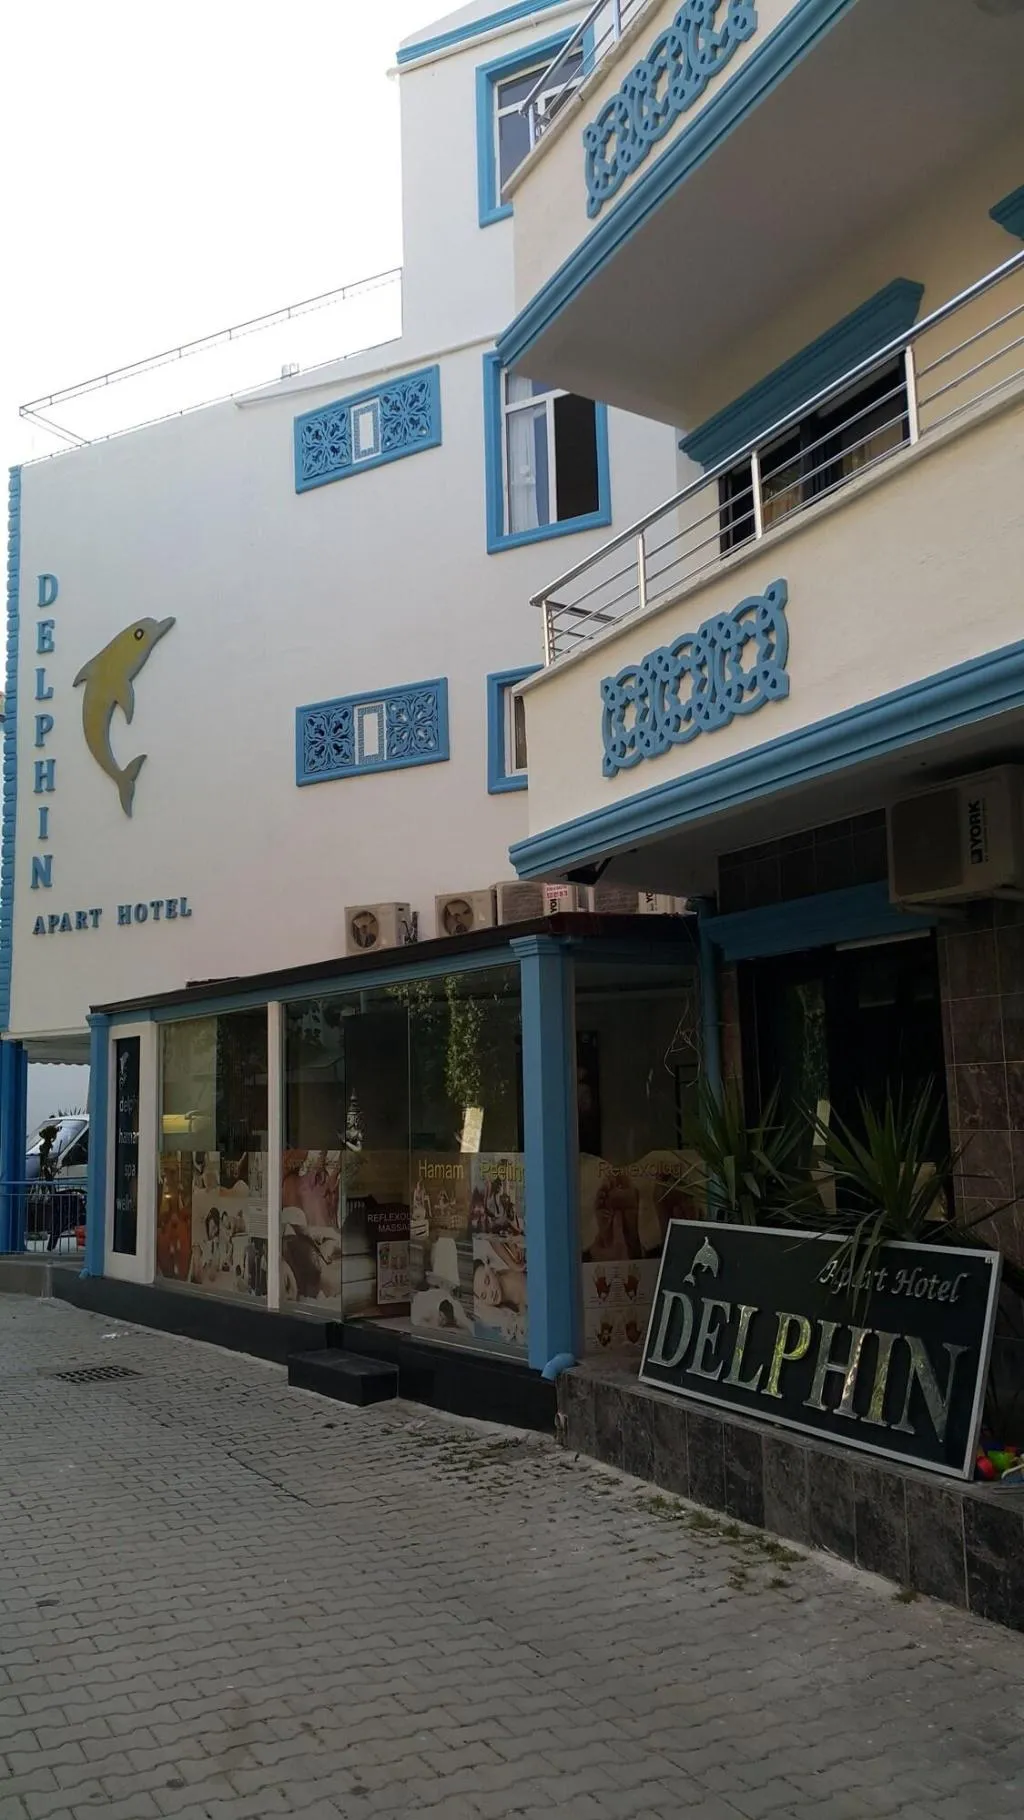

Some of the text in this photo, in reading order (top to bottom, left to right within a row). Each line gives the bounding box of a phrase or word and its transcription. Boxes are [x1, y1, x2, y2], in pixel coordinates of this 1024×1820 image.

[30, 573, 59, 889] DELPHIN
[968, 799, 981, 848] YORK
[32, 897, 192, 935] APART HOTEL
[124, 1163, 136, 1181] spa
[418, 1159, 464, 1180] Hamam
[891, 1266, 970, 1303] Hotel
[648, 1289, 971, 1443] DELPHIN
